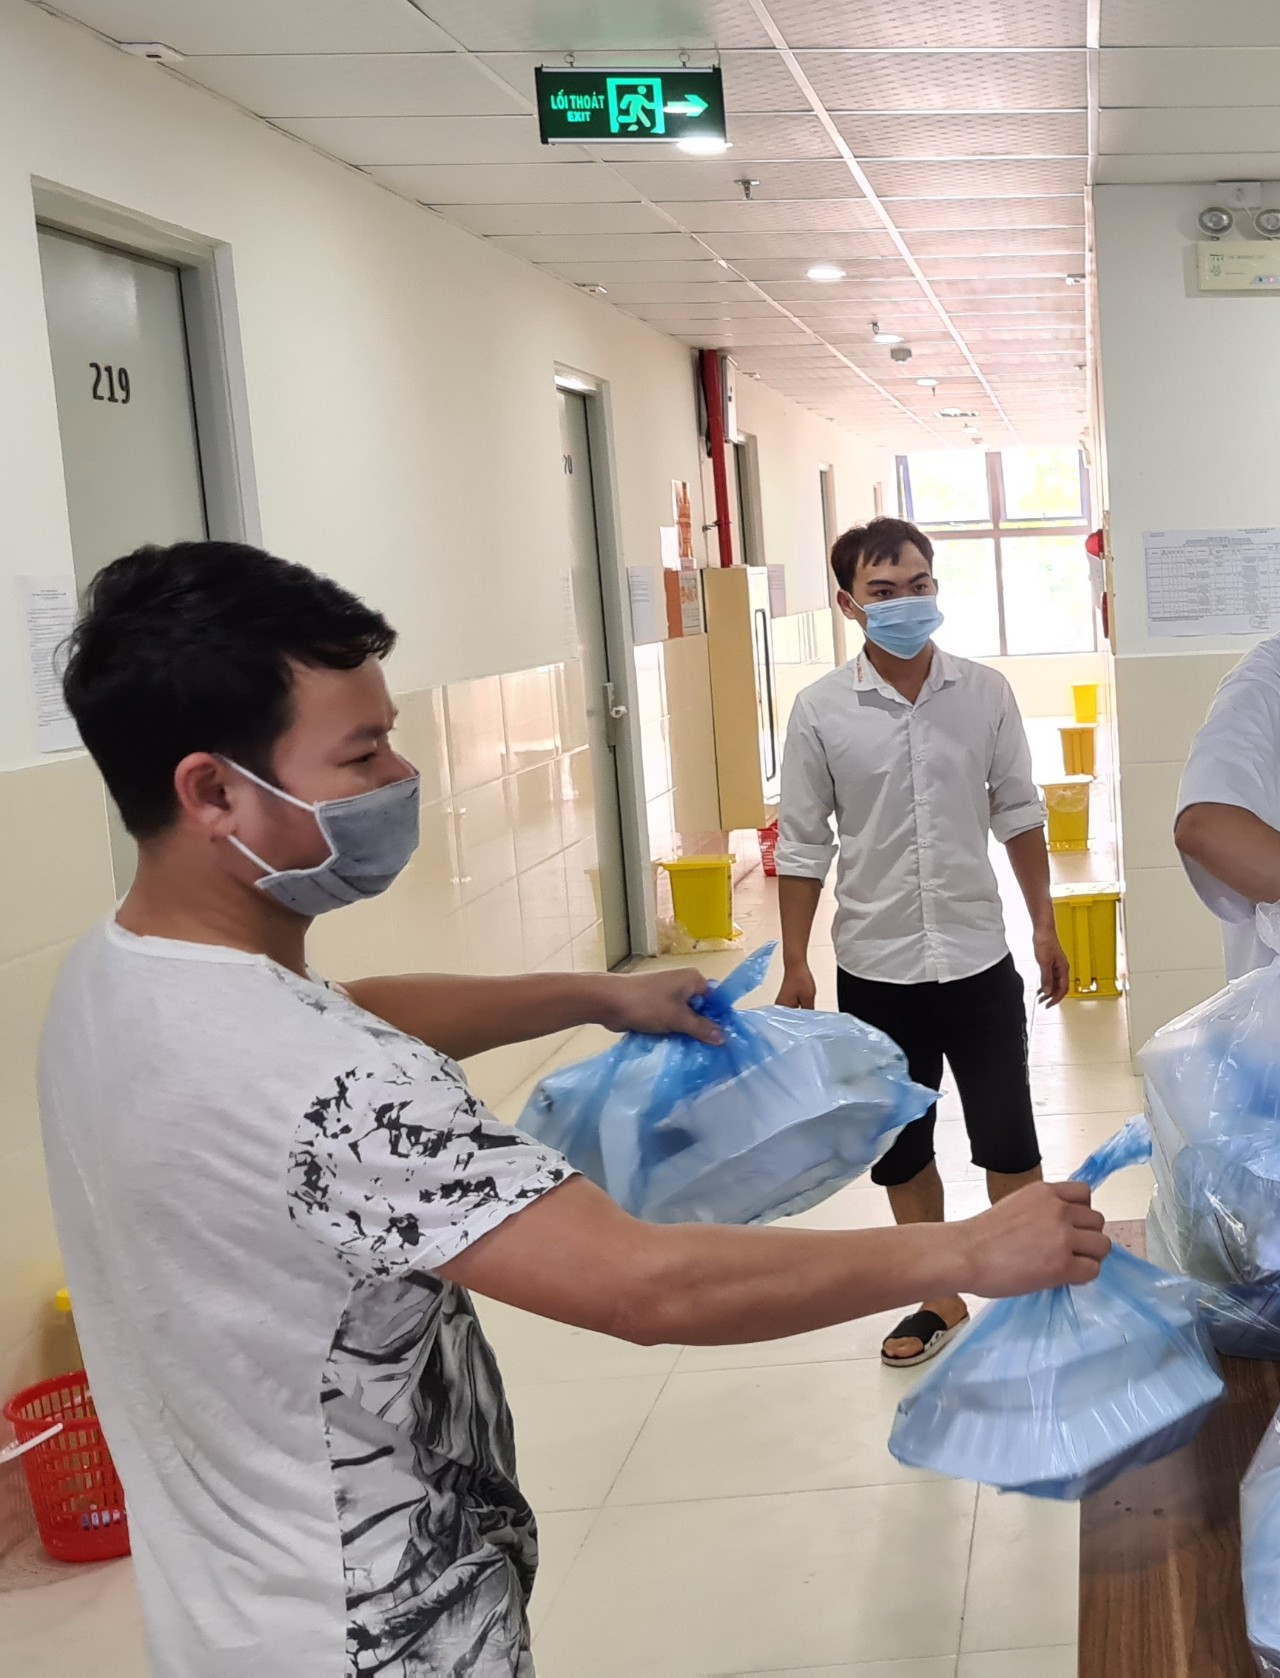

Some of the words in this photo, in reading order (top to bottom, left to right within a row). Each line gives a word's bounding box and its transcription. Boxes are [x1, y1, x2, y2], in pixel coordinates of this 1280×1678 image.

[550, 88, 569, 110] LỐI
[569, 90, 605, 110] THOÁT
[566, 110, 591, 122] EXIT
[89, 362, 130, 404] 219
